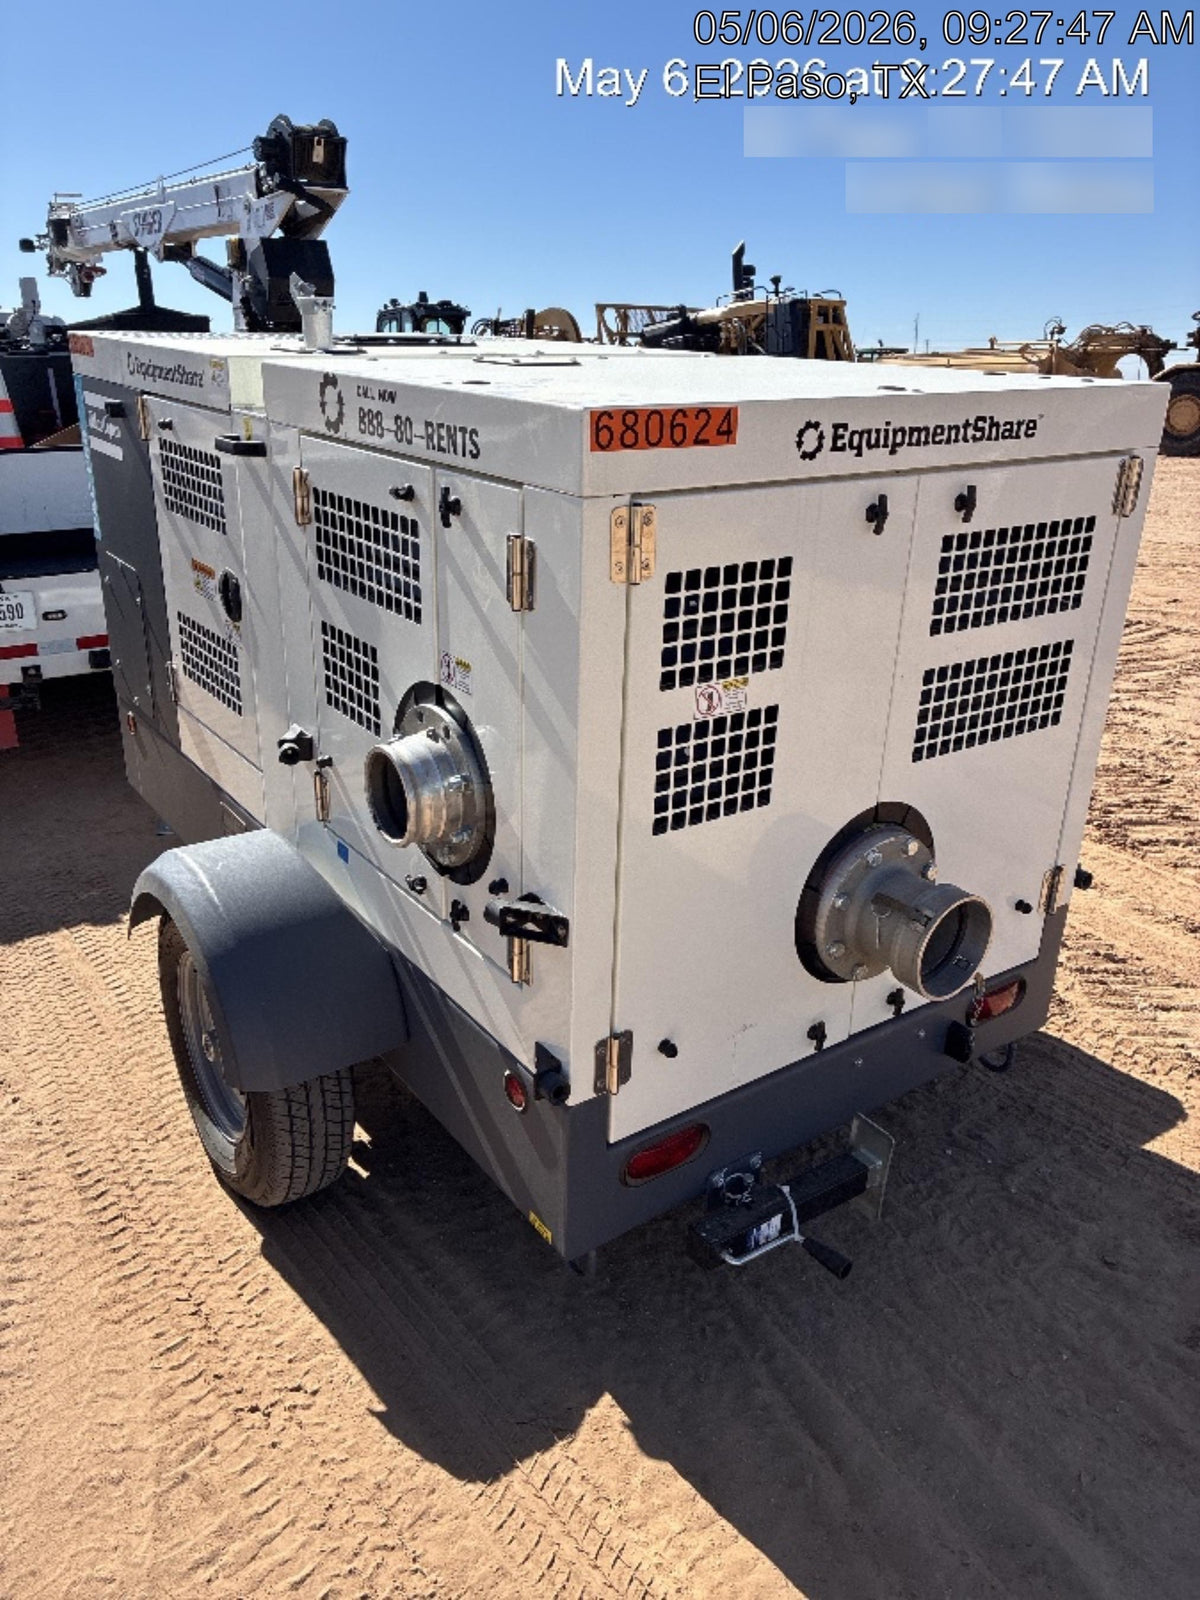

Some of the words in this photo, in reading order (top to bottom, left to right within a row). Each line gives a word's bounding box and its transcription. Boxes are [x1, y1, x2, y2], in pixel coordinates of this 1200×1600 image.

[358, 406, 481, 460] 888-80-RENTS
[594, 408, 734, 451] 680624
[829, 415, 1038, 457] EquipmentShare
